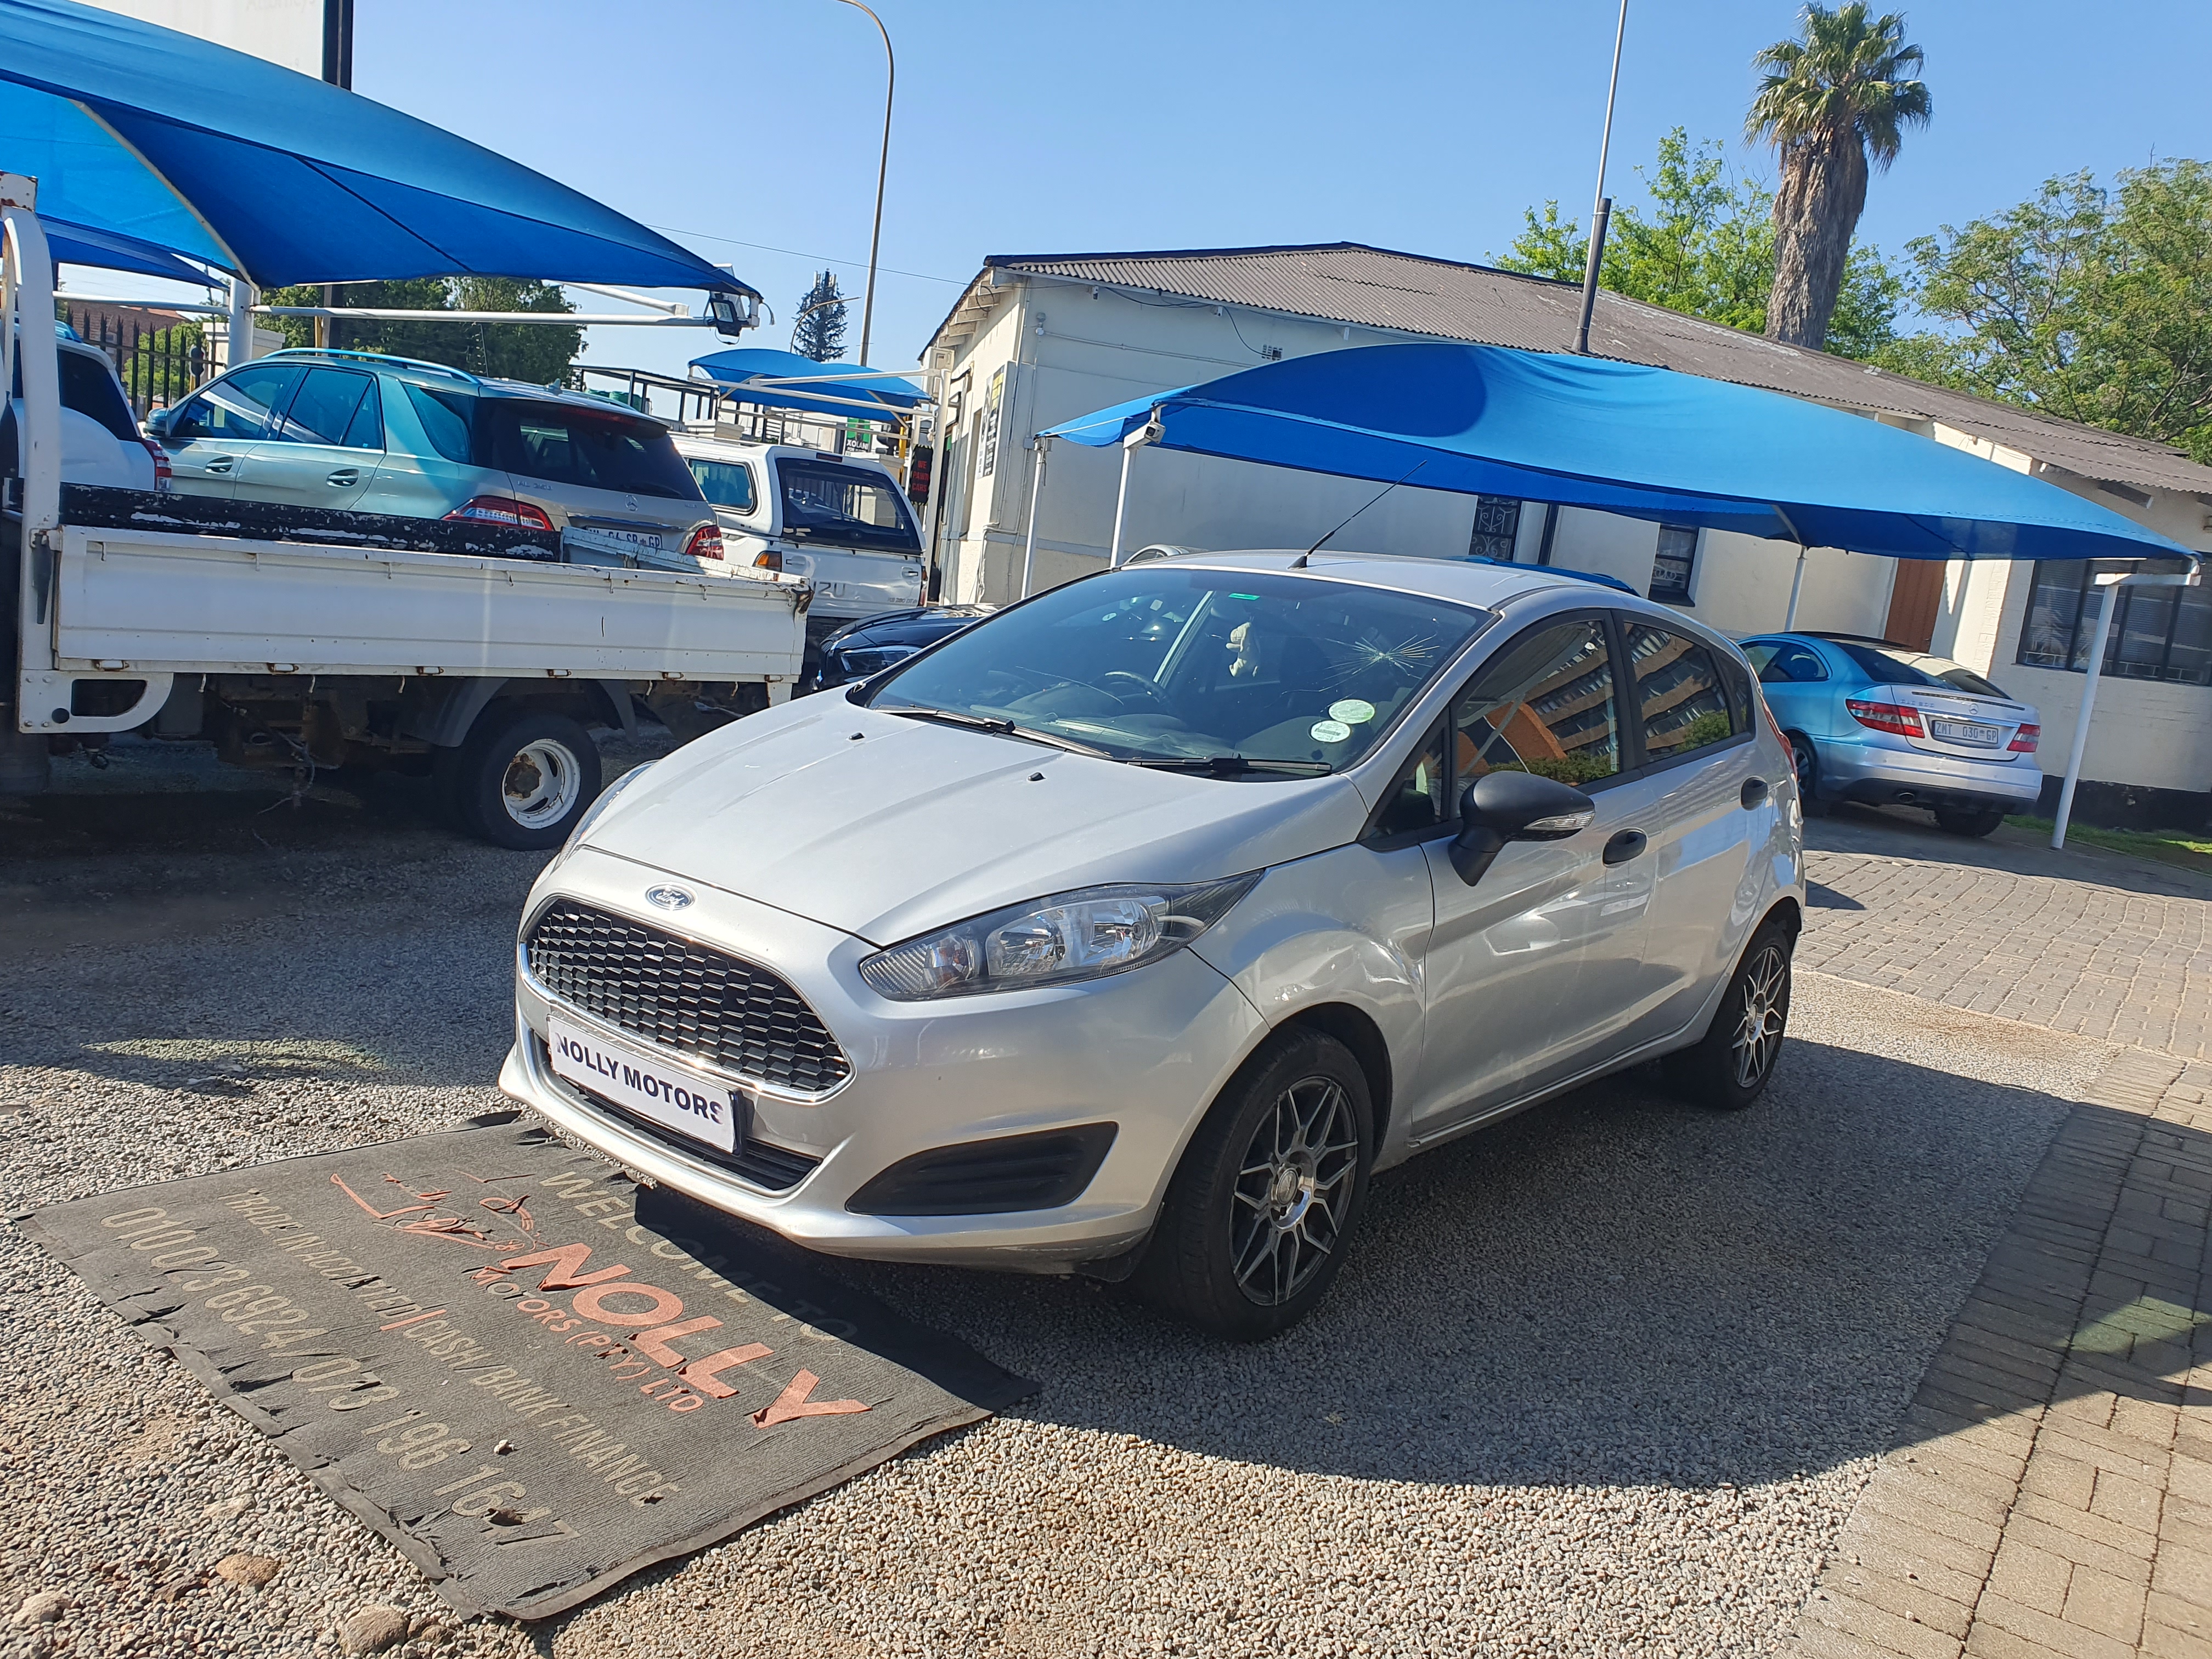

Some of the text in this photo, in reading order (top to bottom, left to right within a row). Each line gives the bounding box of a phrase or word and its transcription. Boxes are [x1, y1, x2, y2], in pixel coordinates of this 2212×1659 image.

[847, 439, 869, 450] XOLANI
[912, 483, 927, 492] CARS
[913, 471, 929, 481] PAWN
[918, 460, 927, 469] WE
[1962, 726, 1978, 739] 030
[1986, 730, 1997, 741] GP
[555, 1031, 724, 1125] NOLLY MOTORS
[539, 1171, 857, 1342] WELCOME TO
[100, 1206, 198, 1251] 010
[150, 1245, 251, 1293] 023
[360, 1408, 475, 1472] 196
[218, 1188, 307, 1234] TRADE
[274, 1232, 326, 1251] IN
[535, 1412, 681, 1508] FINANCE
[469, 1265, 583, 1332] MOTORS
[640, 1377, 704, 1412] LTD
[500, 1242, 872, 1429] NOLLY
